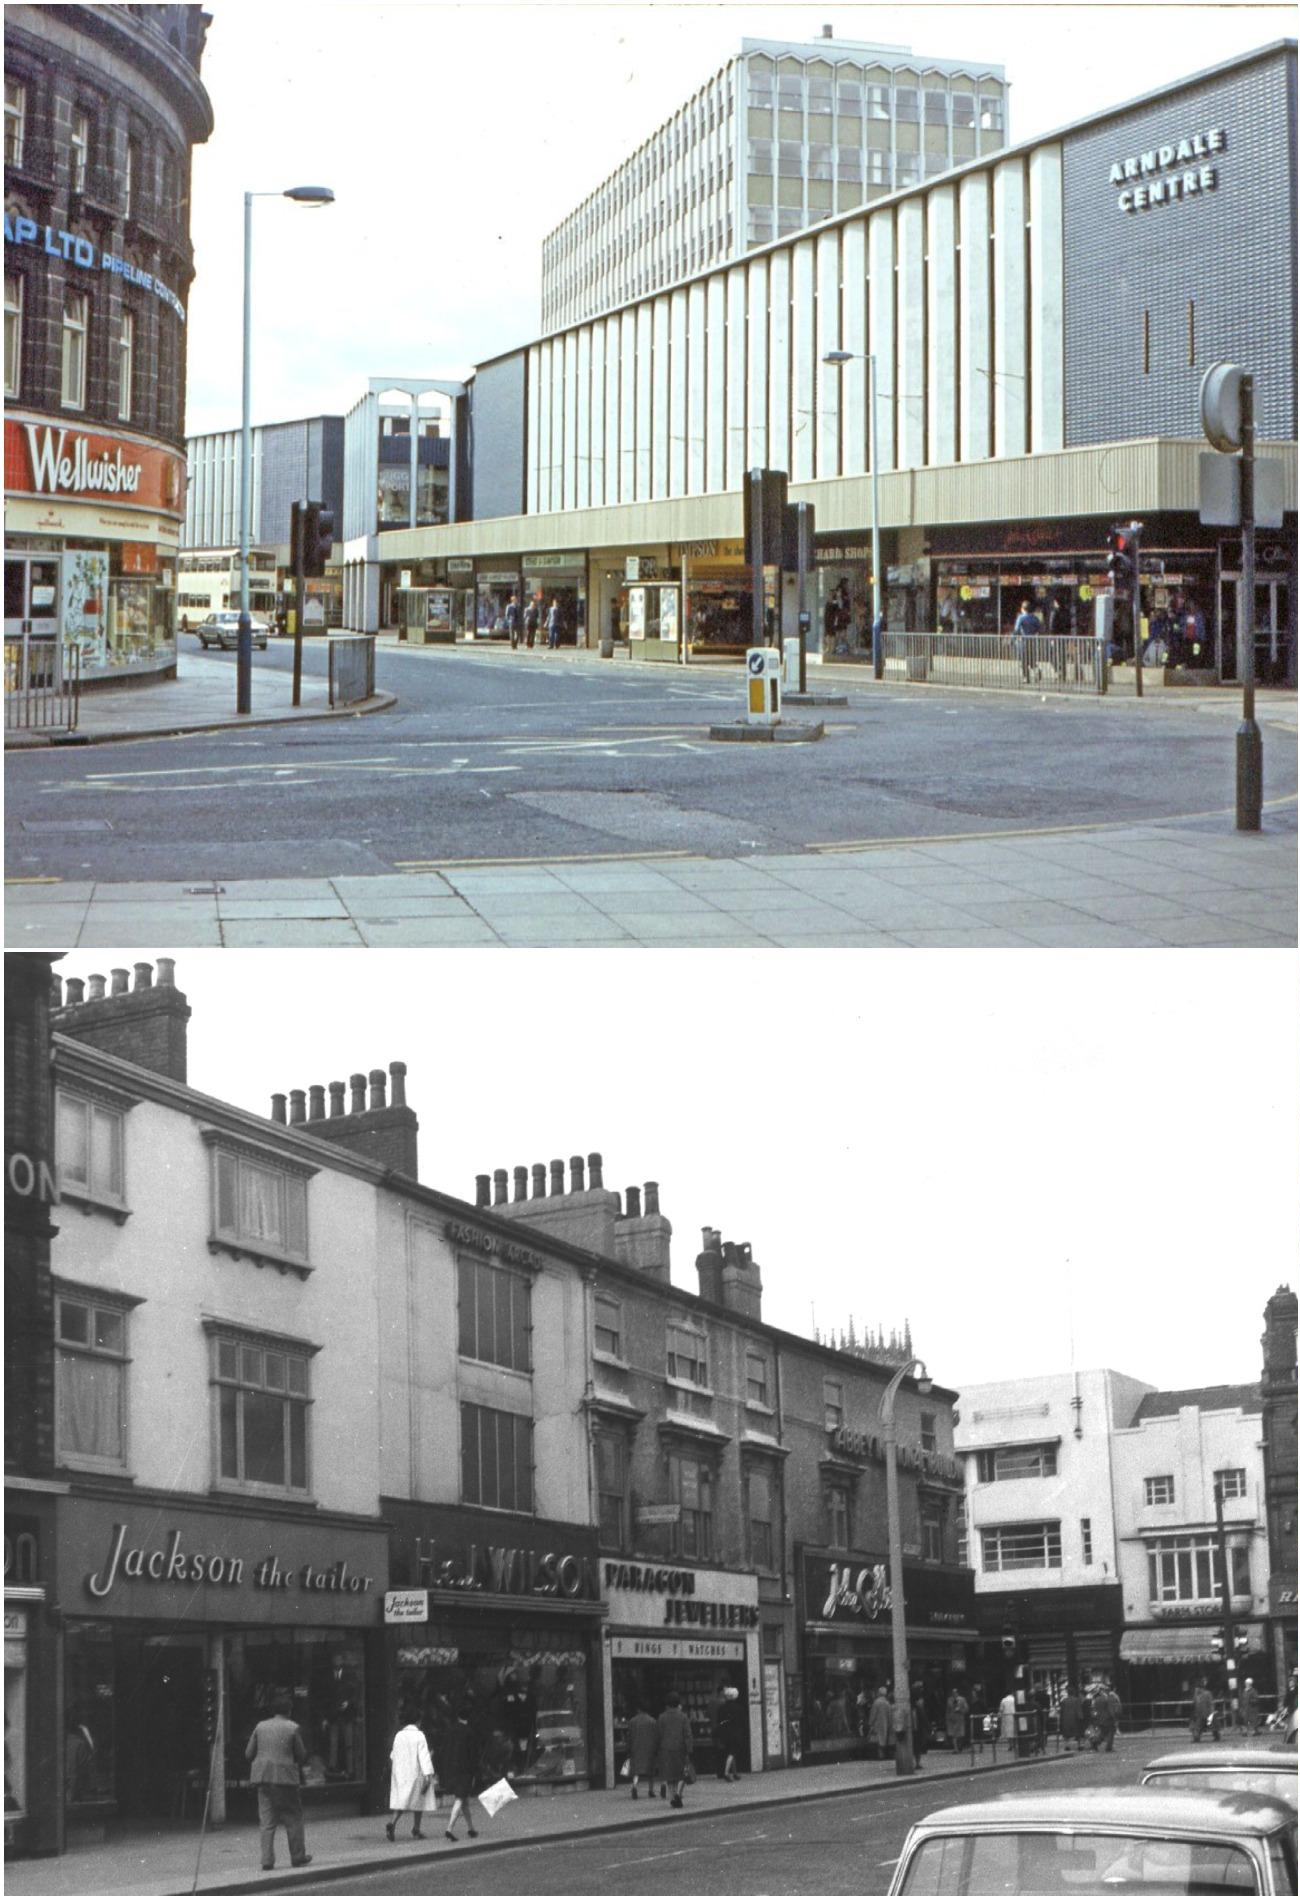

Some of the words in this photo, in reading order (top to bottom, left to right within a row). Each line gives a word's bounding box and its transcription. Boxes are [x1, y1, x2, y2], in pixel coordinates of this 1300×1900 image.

[1109, 128, 1225, 183] ARNDALE
[1118, 164, 1215, 212] CENTRE
[45, 225, 94, 268] LTD
[102, 252, 152, 288] PIPELINE
[24, 423, 142, 493] Wellwisher
[90, 1524, 244, 1597] Jackson
[260, 1556, 293, 1587] the
[305, 1561, 374, 1592] tailor
[605, 1563, 695, 1595] PARAGON
[664, 1599, 760, 1628] JEWELLERS
[688, 1644, 727, 1657] WATCHES
